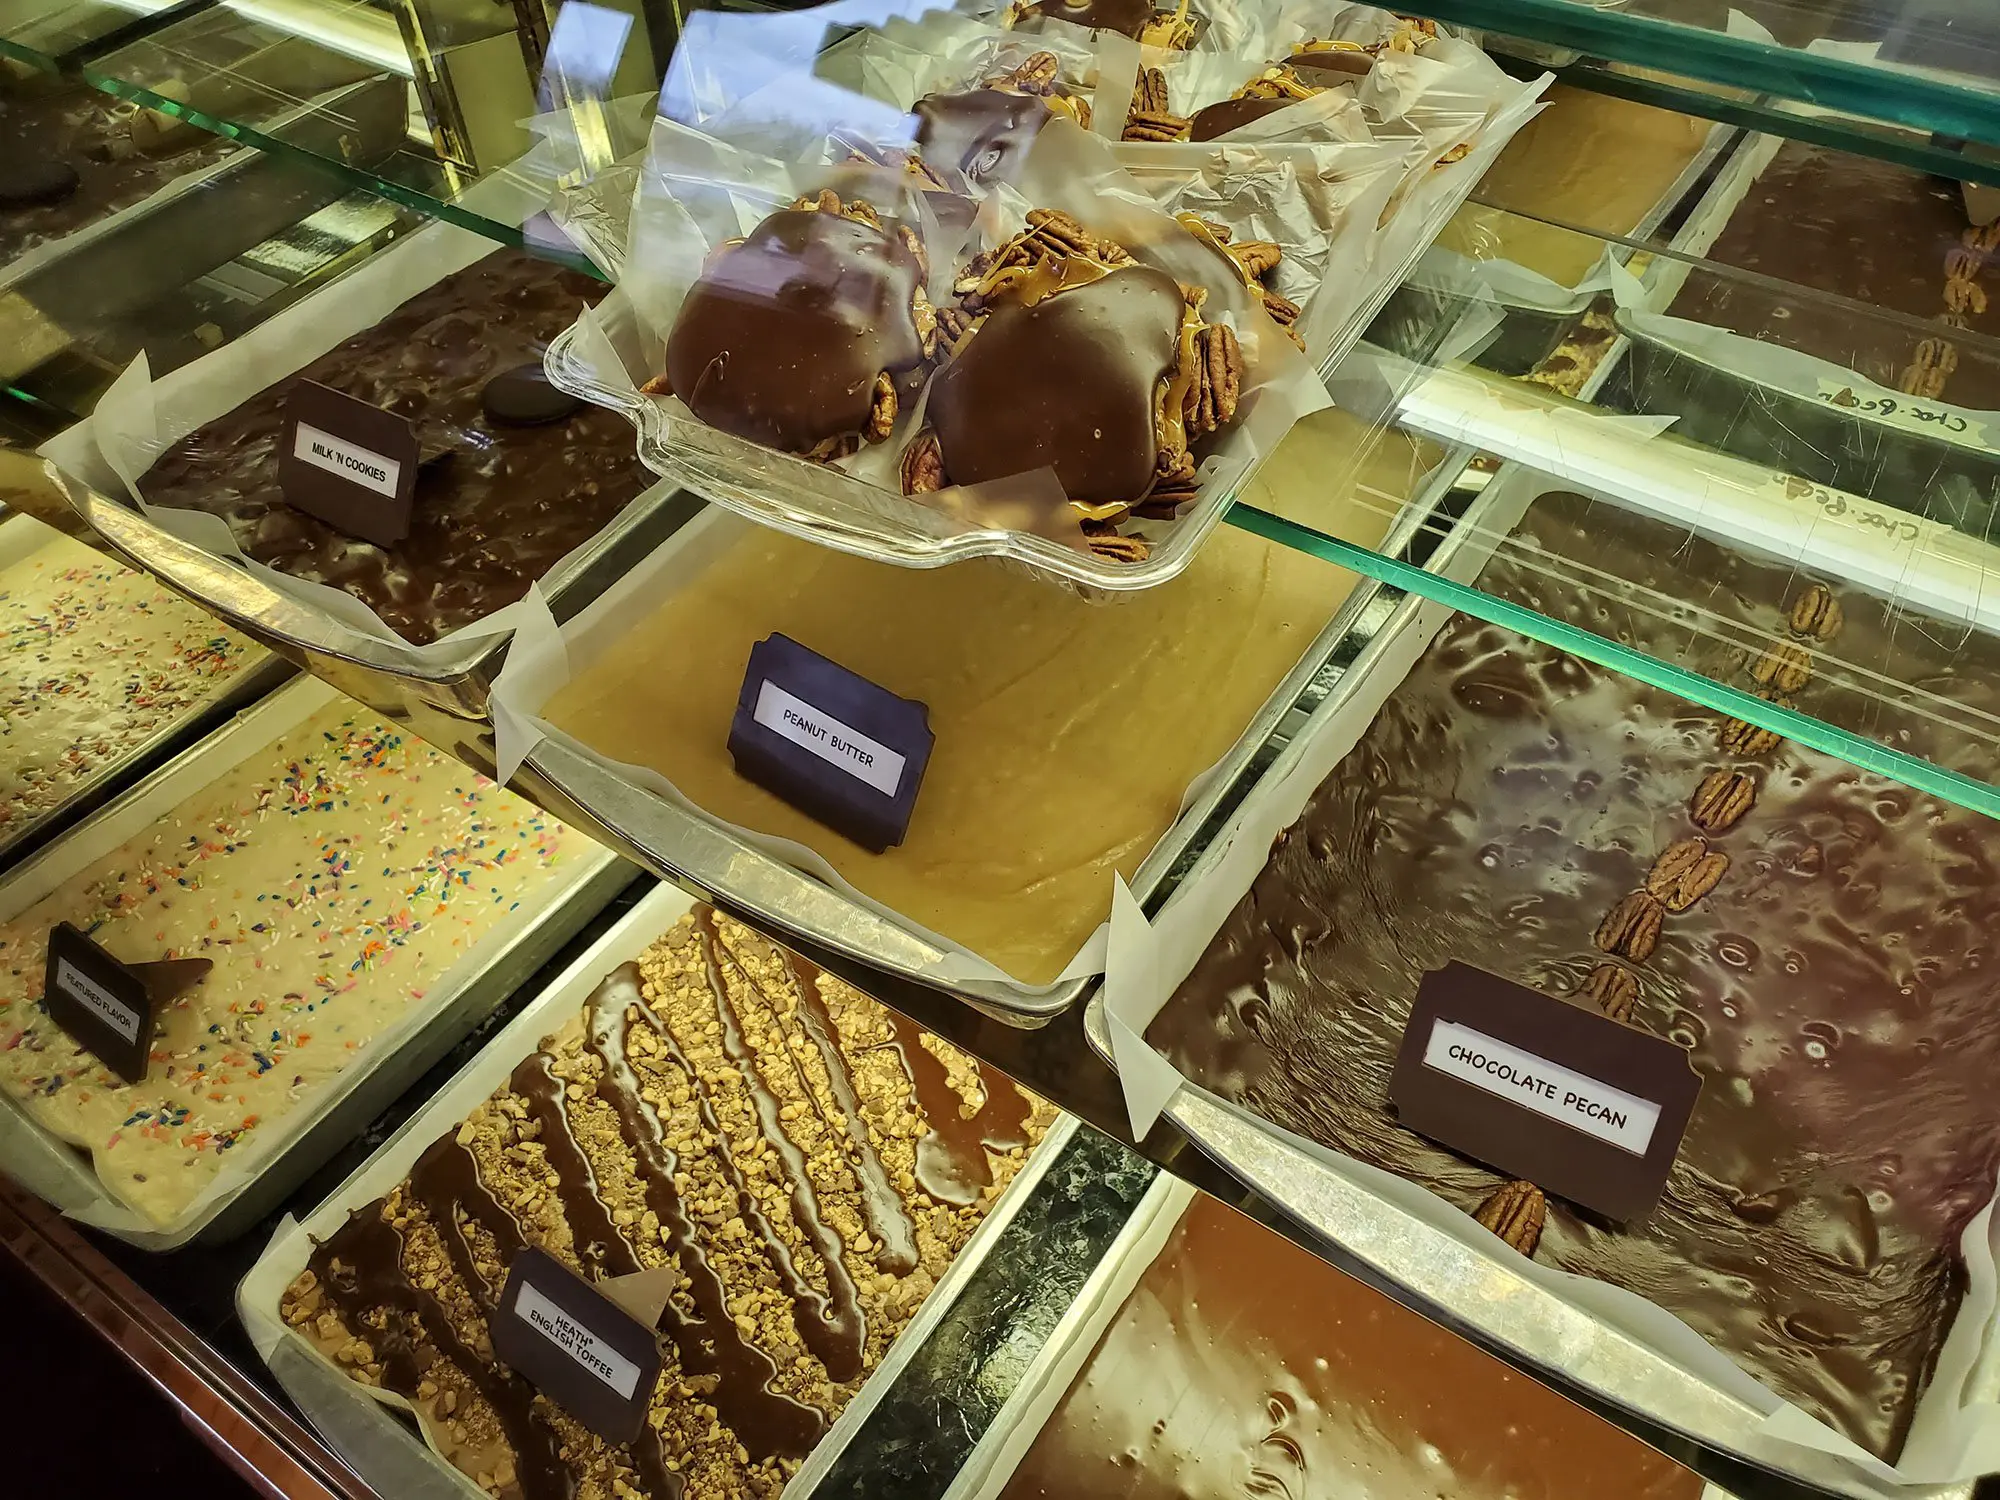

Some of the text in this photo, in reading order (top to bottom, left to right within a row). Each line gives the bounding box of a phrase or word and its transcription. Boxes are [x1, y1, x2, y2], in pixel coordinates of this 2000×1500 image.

[312, 442, 333, 460] MILK
[345, 457, 387, 482] COOKIES
[783, 709, 874, 768] PEANUT BUTTER
[65, 973, 131, 1029] FEATURED FLAVOR
[1449, 1044, 1627, 1129] CHOCOLATE PECAN
[530, 1309, 613, 1379] ENGLISH TOFFEE
